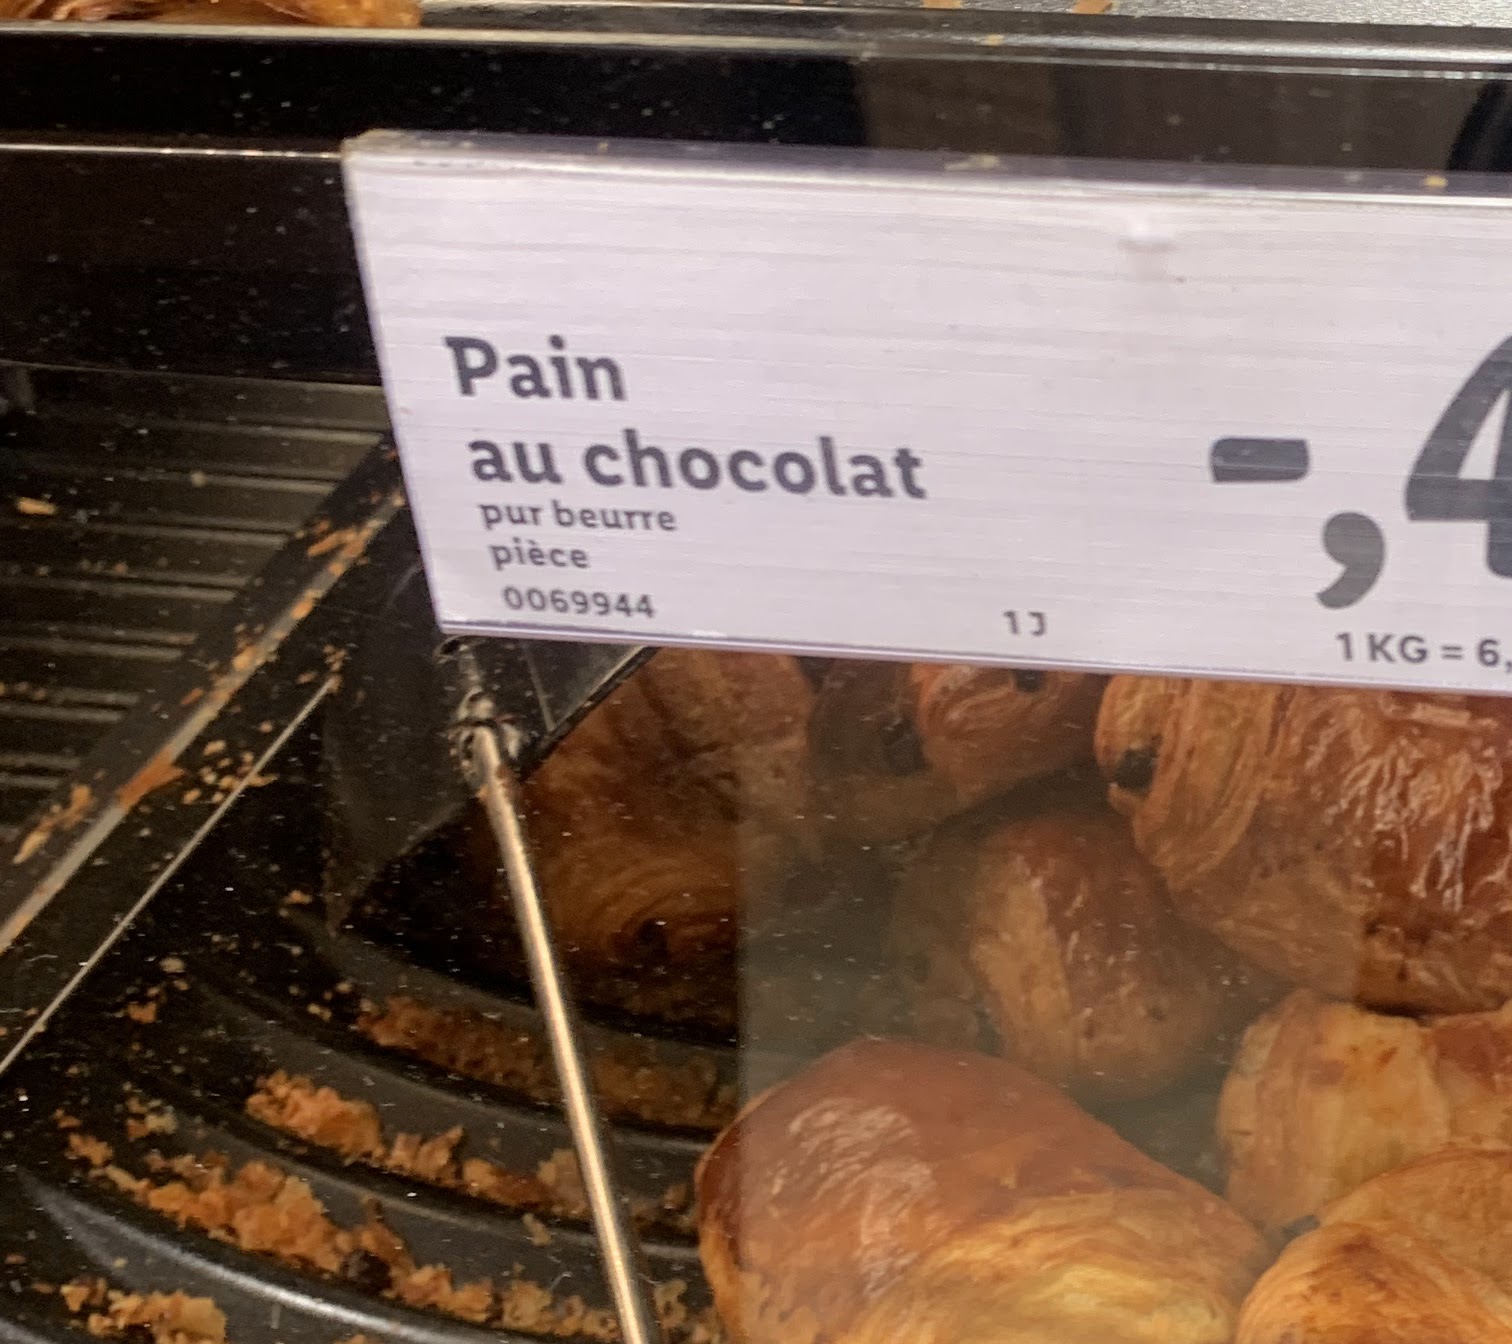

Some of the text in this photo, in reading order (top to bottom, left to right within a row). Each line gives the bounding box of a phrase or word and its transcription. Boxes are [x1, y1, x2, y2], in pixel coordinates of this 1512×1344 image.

[444, 335, 627, 400] Pain
[469, 429, 927, 499] au chocolat
[480, 500, 676, 532] pur beurre
[490, 537, 588, 569] pièce
[503, 586, 655, 619] 0069944
[1336, 632, 1354, 661] 1
[1369, 633, 1429, 664] KG
[1442, 643, 1463, 660] =
